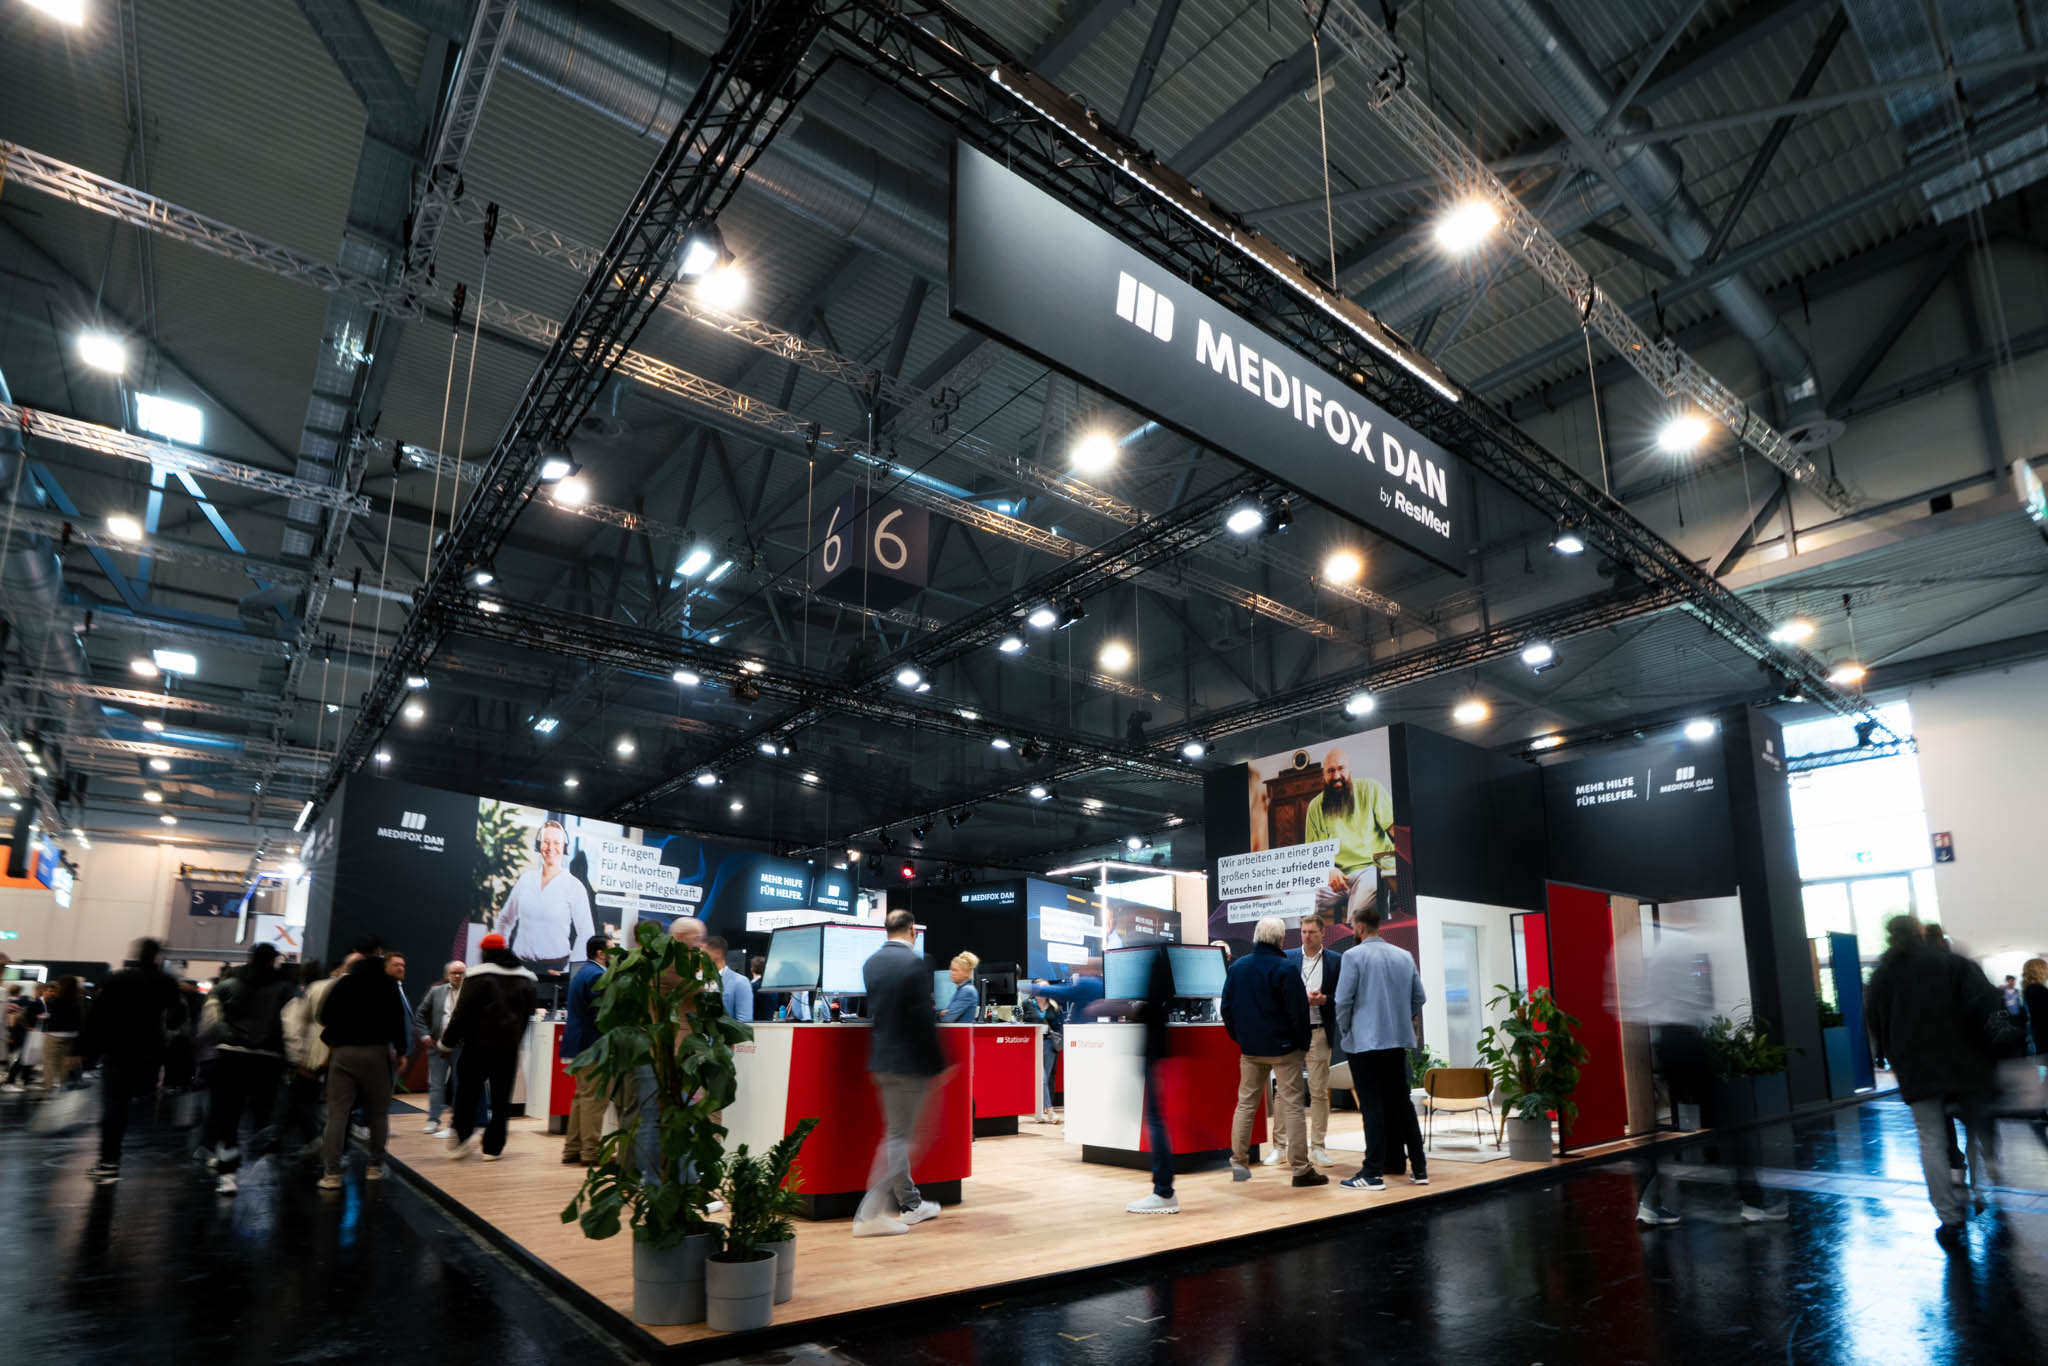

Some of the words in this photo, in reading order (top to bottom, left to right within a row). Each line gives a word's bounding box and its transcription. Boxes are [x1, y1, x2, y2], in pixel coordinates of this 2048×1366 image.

[1195, 319, 1375, 464] MEDIFOX
[1382, 431, 1448, 507] DAN
[1380, 487, 1392, 507] by
[1394, 490, 1450, 539] ResMed
[823, 506, 841, 573] 6
[874, 508, 907, 570] 6
[1575, 781, 1605, 795] MEHR
[1606, 776, 1634, 789] HILFE
[1660, 781, 1695, 793] MEDIFOX
[1695, 778, 1714, 788] DAN
[1576, 794, 1596, 807] FÜR
[1597, 789, 1637, 803] HELFER.
[377, 828, 422, 842] MEDIFOX
[424, 835, 445, 846] DAN
[602, 841, 618, 853] Für
[621, 845, 656, 861] Fragen.
[1221, 858, 1235, 868] Wir
[1237, 854, 1272, 867] arbeiten
[1274, 851, 1286, 860] an
[1287, 847, 1310, 858] einer
[1312, 843, 1335, 857] ganz
[601, 858, 617, 870] Für
[620, 861, 675, 880] Antworten.
[1221, 870, 1250, 885] großen
[1252, 867, 1280, 879] Sache:
[1281, 859, 1330, 874] zufriedene
[600, 875, 616, 886] Für
[619, 878, 642, 891] volle
[645, 882, 699, 898] Pflegekraft.
[761, 874, 783, 885] MEHR
[784, 877, 803, 888] HILFE
[1221, 884, 1263, 896] Menschen
[1265, 882, 1273, 891] in
[1275, 880, 1290, 889] der
[1292, 875, 1324, 888] Pflege.
[761, 885, 775, 896] FÜR
[777, 889, 804, 900] HELFER.
[970, 892, 999, 902] MEDIFOX
[1000, 891, 1015, 899] DAN
[649, 903, 676, 912] MEDIFOX
[1230, 902, 1239, 911] Für
[1239, 901, 1252, 910] volle
[1004, 1035, 1030, 1044] Stationär
